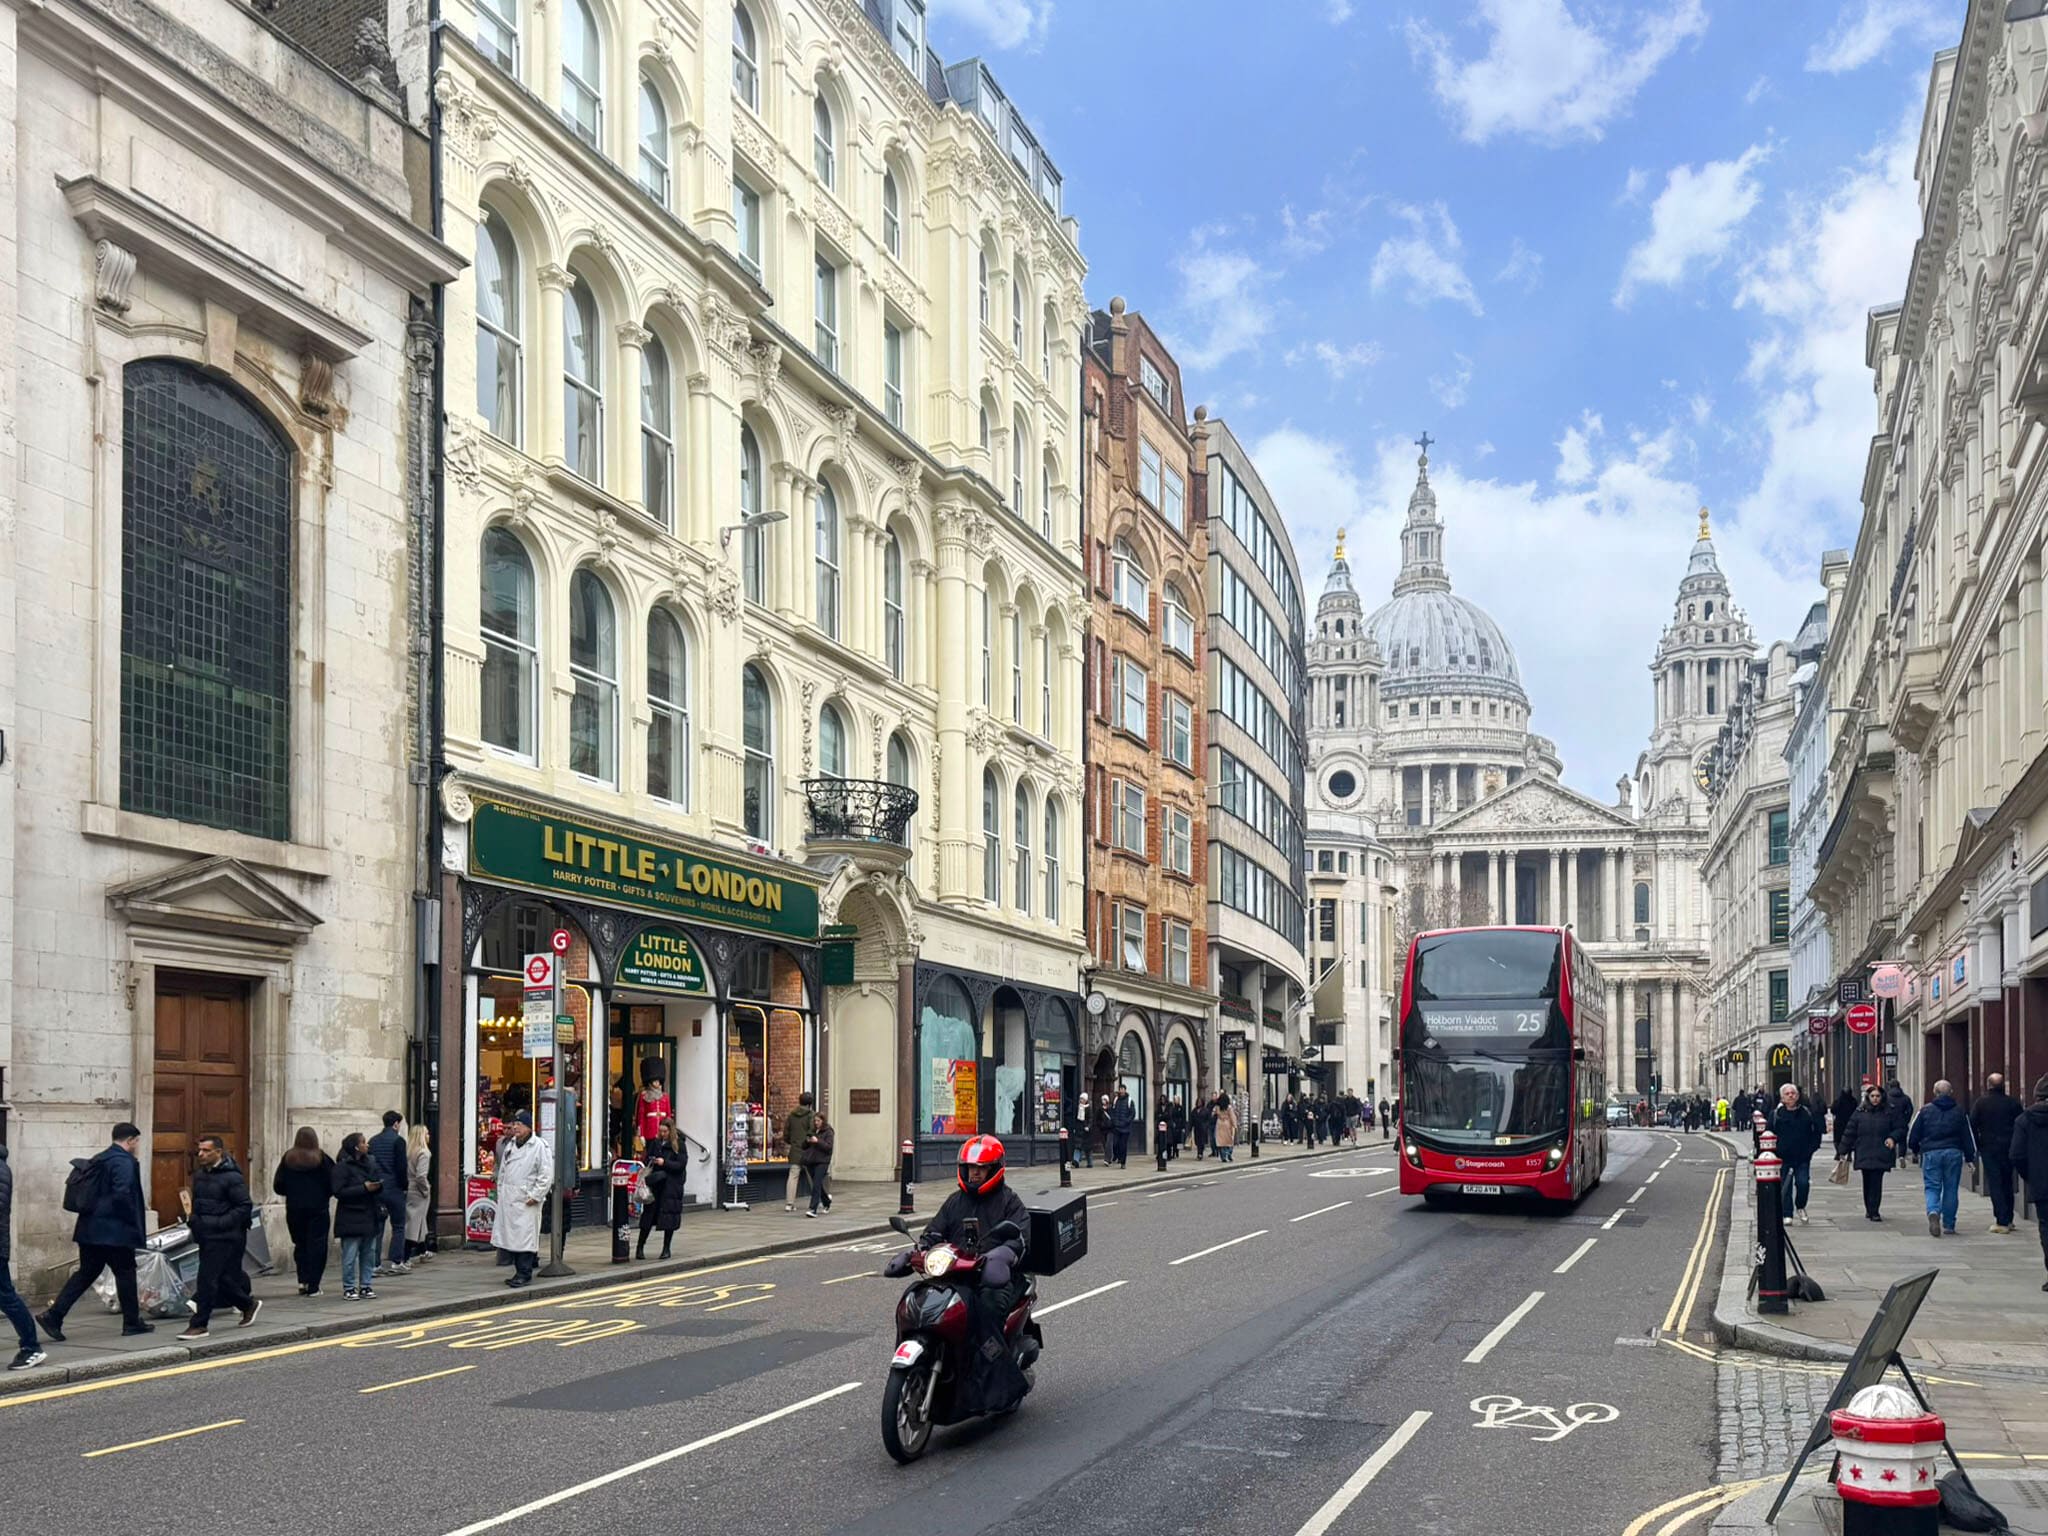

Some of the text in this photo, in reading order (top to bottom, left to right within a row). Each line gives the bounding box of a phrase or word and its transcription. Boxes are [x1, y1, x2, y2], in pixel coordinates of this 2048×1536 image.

[544, 825, 782, 912] LITTLE LONDON
[552, 869, 583, 884] HARRY
[584, 876, 617, 891] POTTER
[622, 884, 646, 898] GIFTS
[553, 932, 567, 950] G
[640, 933, 687, 954] LITTLE
[635, 951, 691, 972] LONDON
[1426, 1014, 1497, 1025] Holborn Viaduct
[1516, 1012, 1541, 1032] 25
[1465, 1160, 1504, 1168] Stagecoach
[556, 1283, 777, 1308] BUS
[896, 1343, 911, 1359] L
